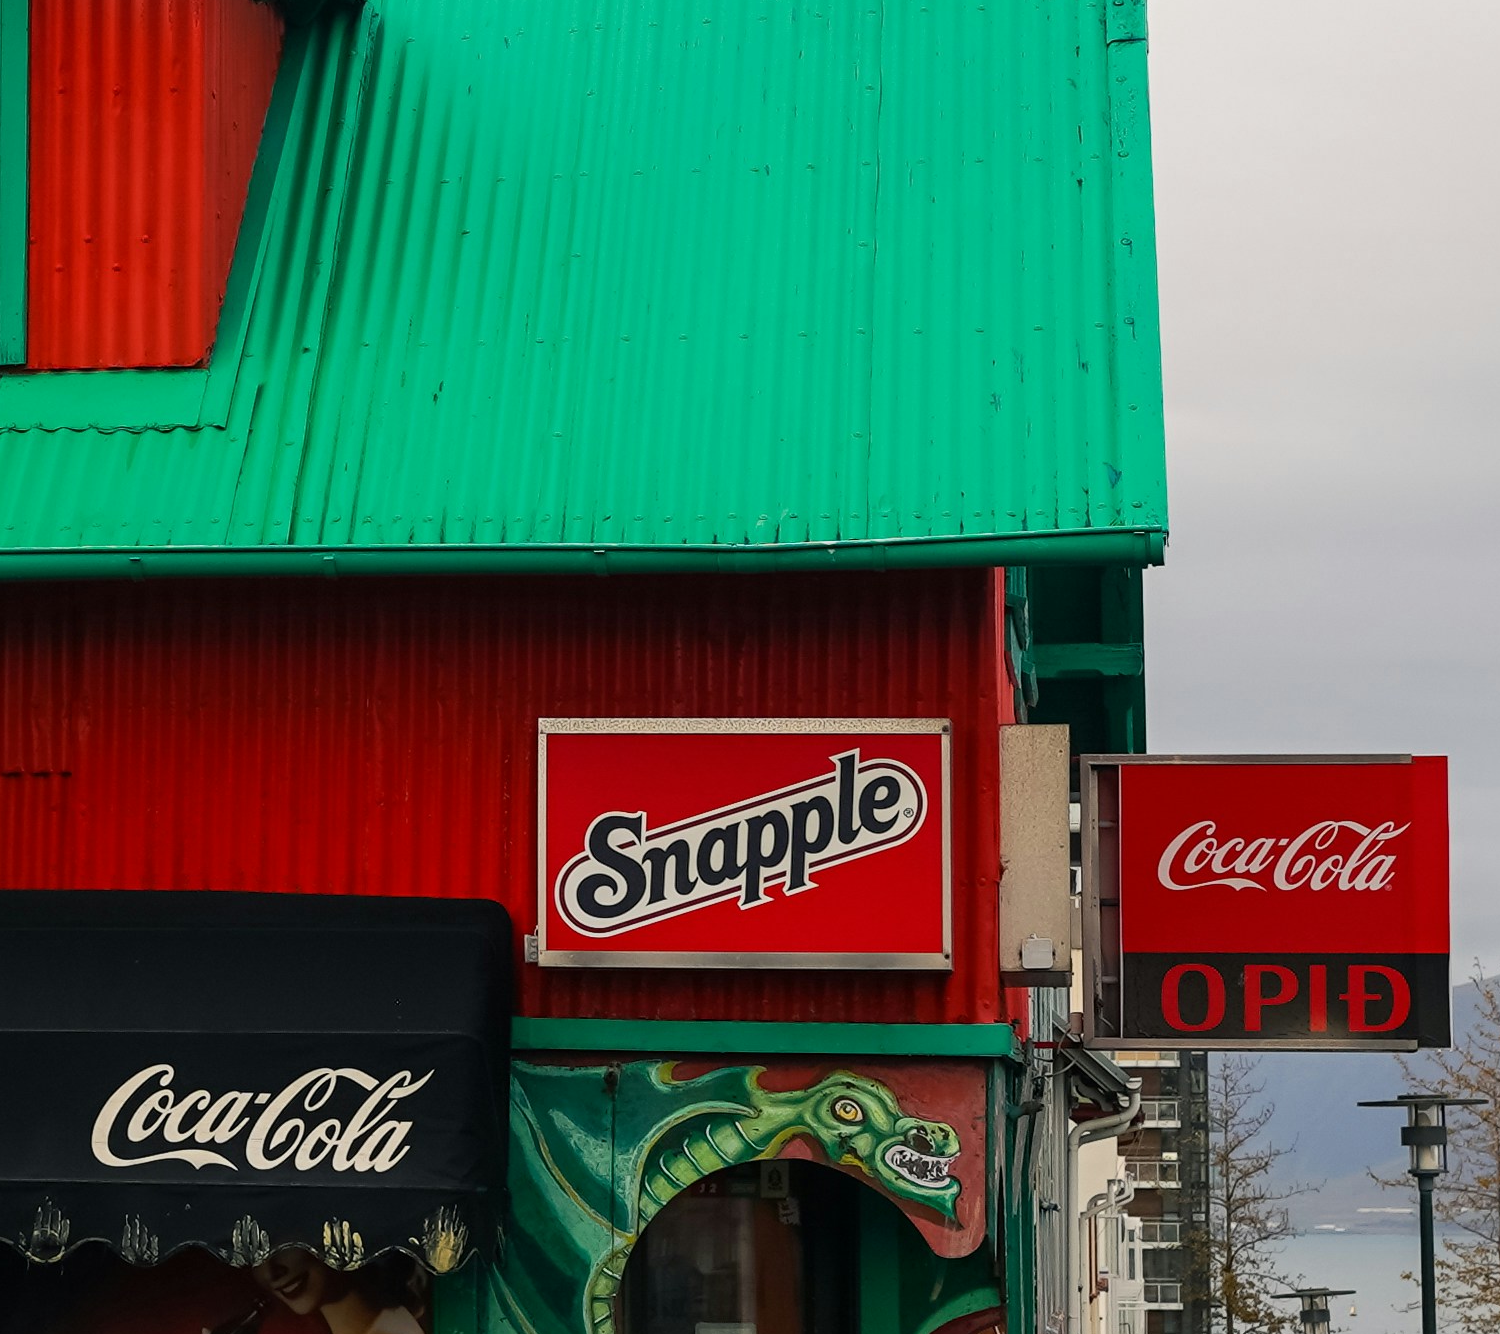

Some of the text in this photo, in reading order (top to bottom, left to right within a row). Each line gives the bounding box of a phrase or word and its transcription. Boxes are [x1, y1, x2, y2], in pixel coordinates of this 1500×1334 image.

[575, 752, 902, 920] Snapple
[1157, 820, 1412, 892] Coca-Cola
[1161, 963, 1411, 1033] OPIÐ
[91, 1064, 435, 1173] Coca-Cola
